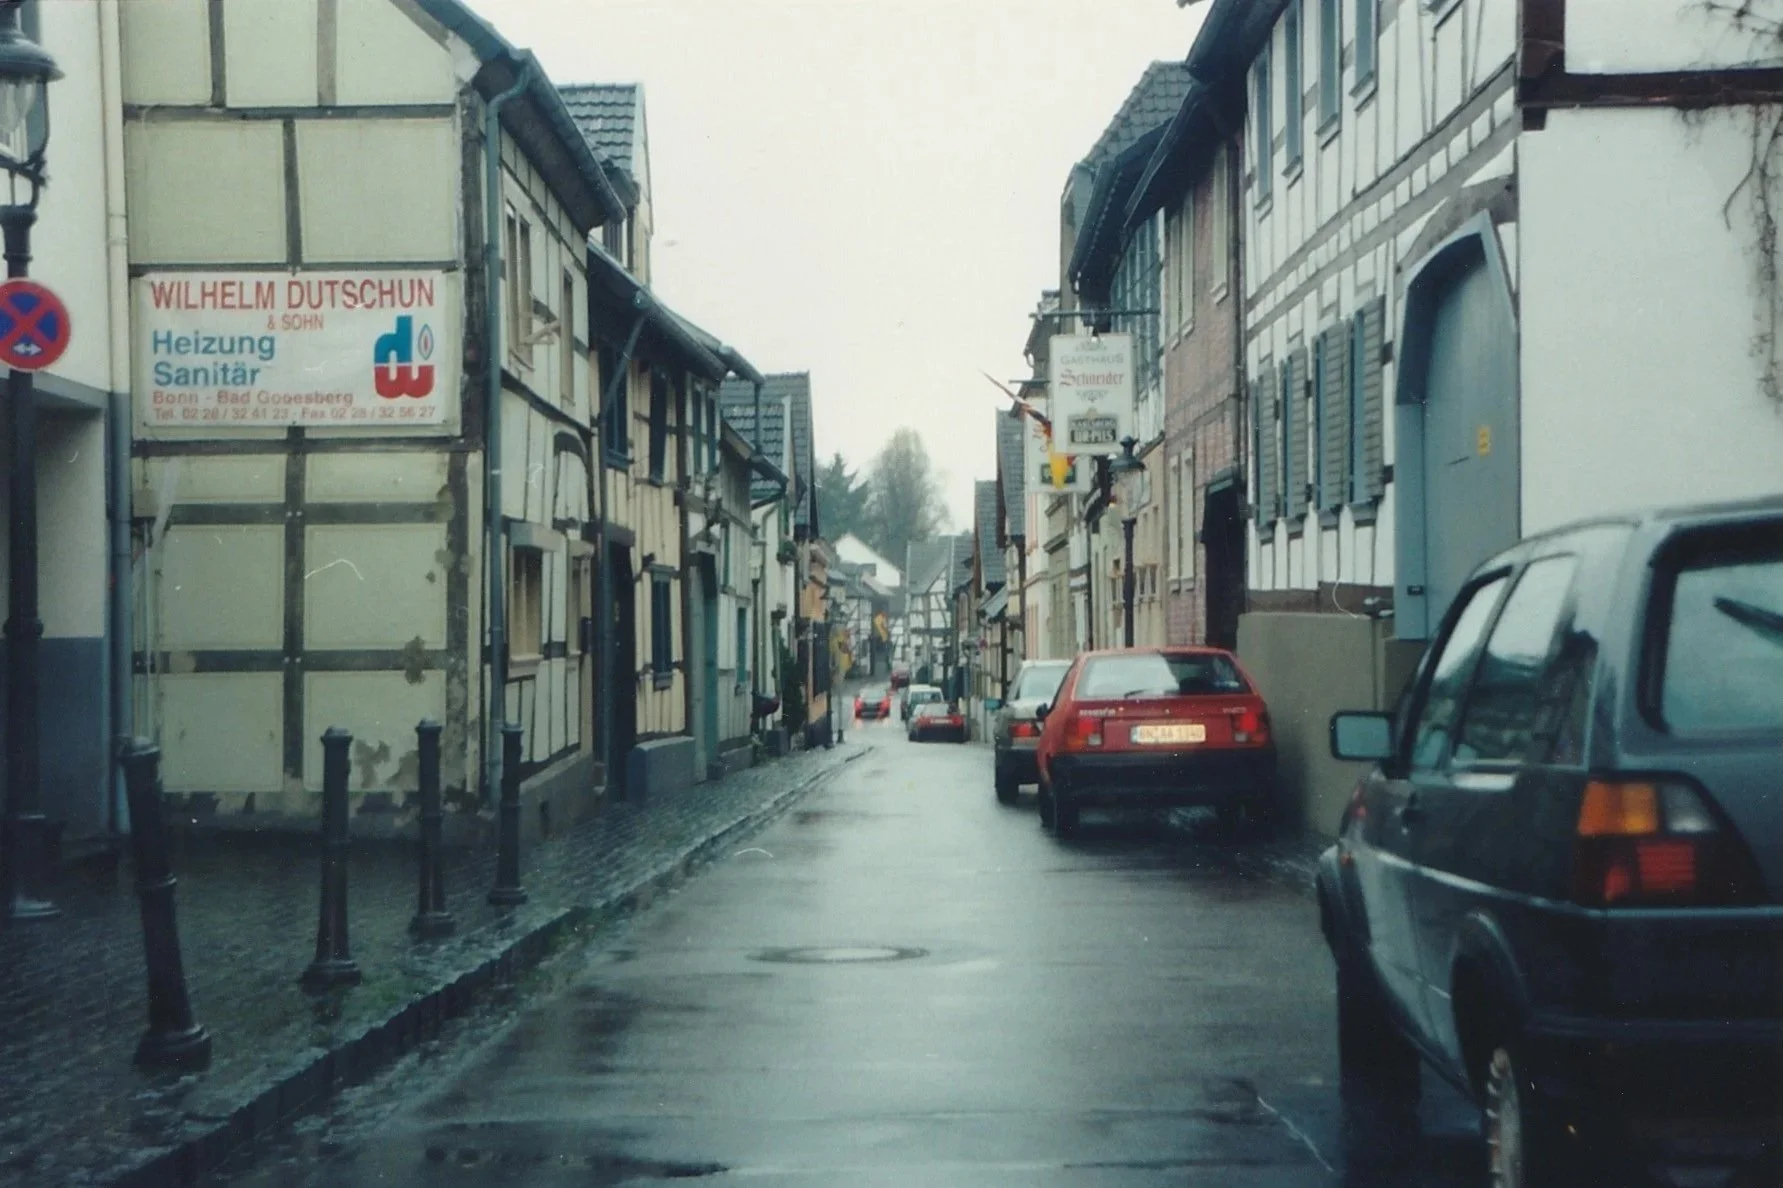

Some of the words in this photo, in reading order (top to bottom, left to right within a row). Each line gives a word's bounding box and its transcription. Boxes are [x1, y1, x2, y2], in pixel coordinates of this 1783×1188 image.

[151, 280, 275, 309] WILHELM
[287, 278, 434, 309] DUTSCHUN
[266, 315, 276, 330] &
[281, 314, 324, 330] SOHN
[153, 330, 275, 361] Heizung
[153, 361, 261, 386] Sanitär
[1059, 368, 1124, 386] Schneider
[152, 390, 198, 404] Bonn
[216, 390, 251, 404] Bad
[301, 407, 326, 418] Fax
